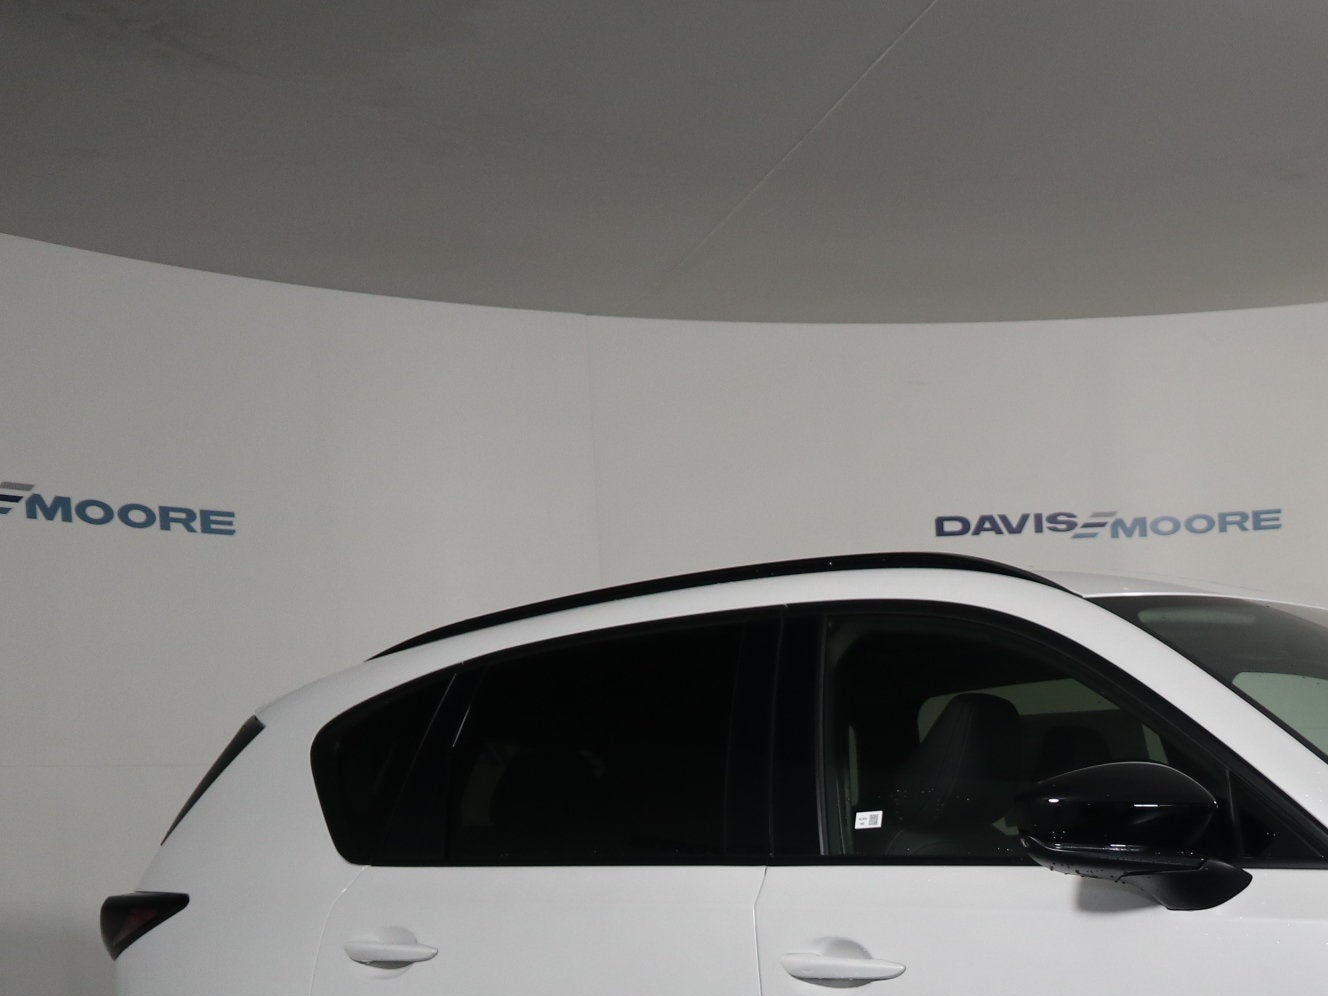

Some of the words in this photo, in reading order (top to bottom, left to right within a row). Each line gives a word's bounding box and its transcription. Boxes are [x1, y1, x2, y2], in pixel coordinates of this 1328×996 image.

[25, 493, 236, 535] MOORE
[934, 511, 1079, 537] DAVIS
[1110, 508, 1283, 539] MOORE
